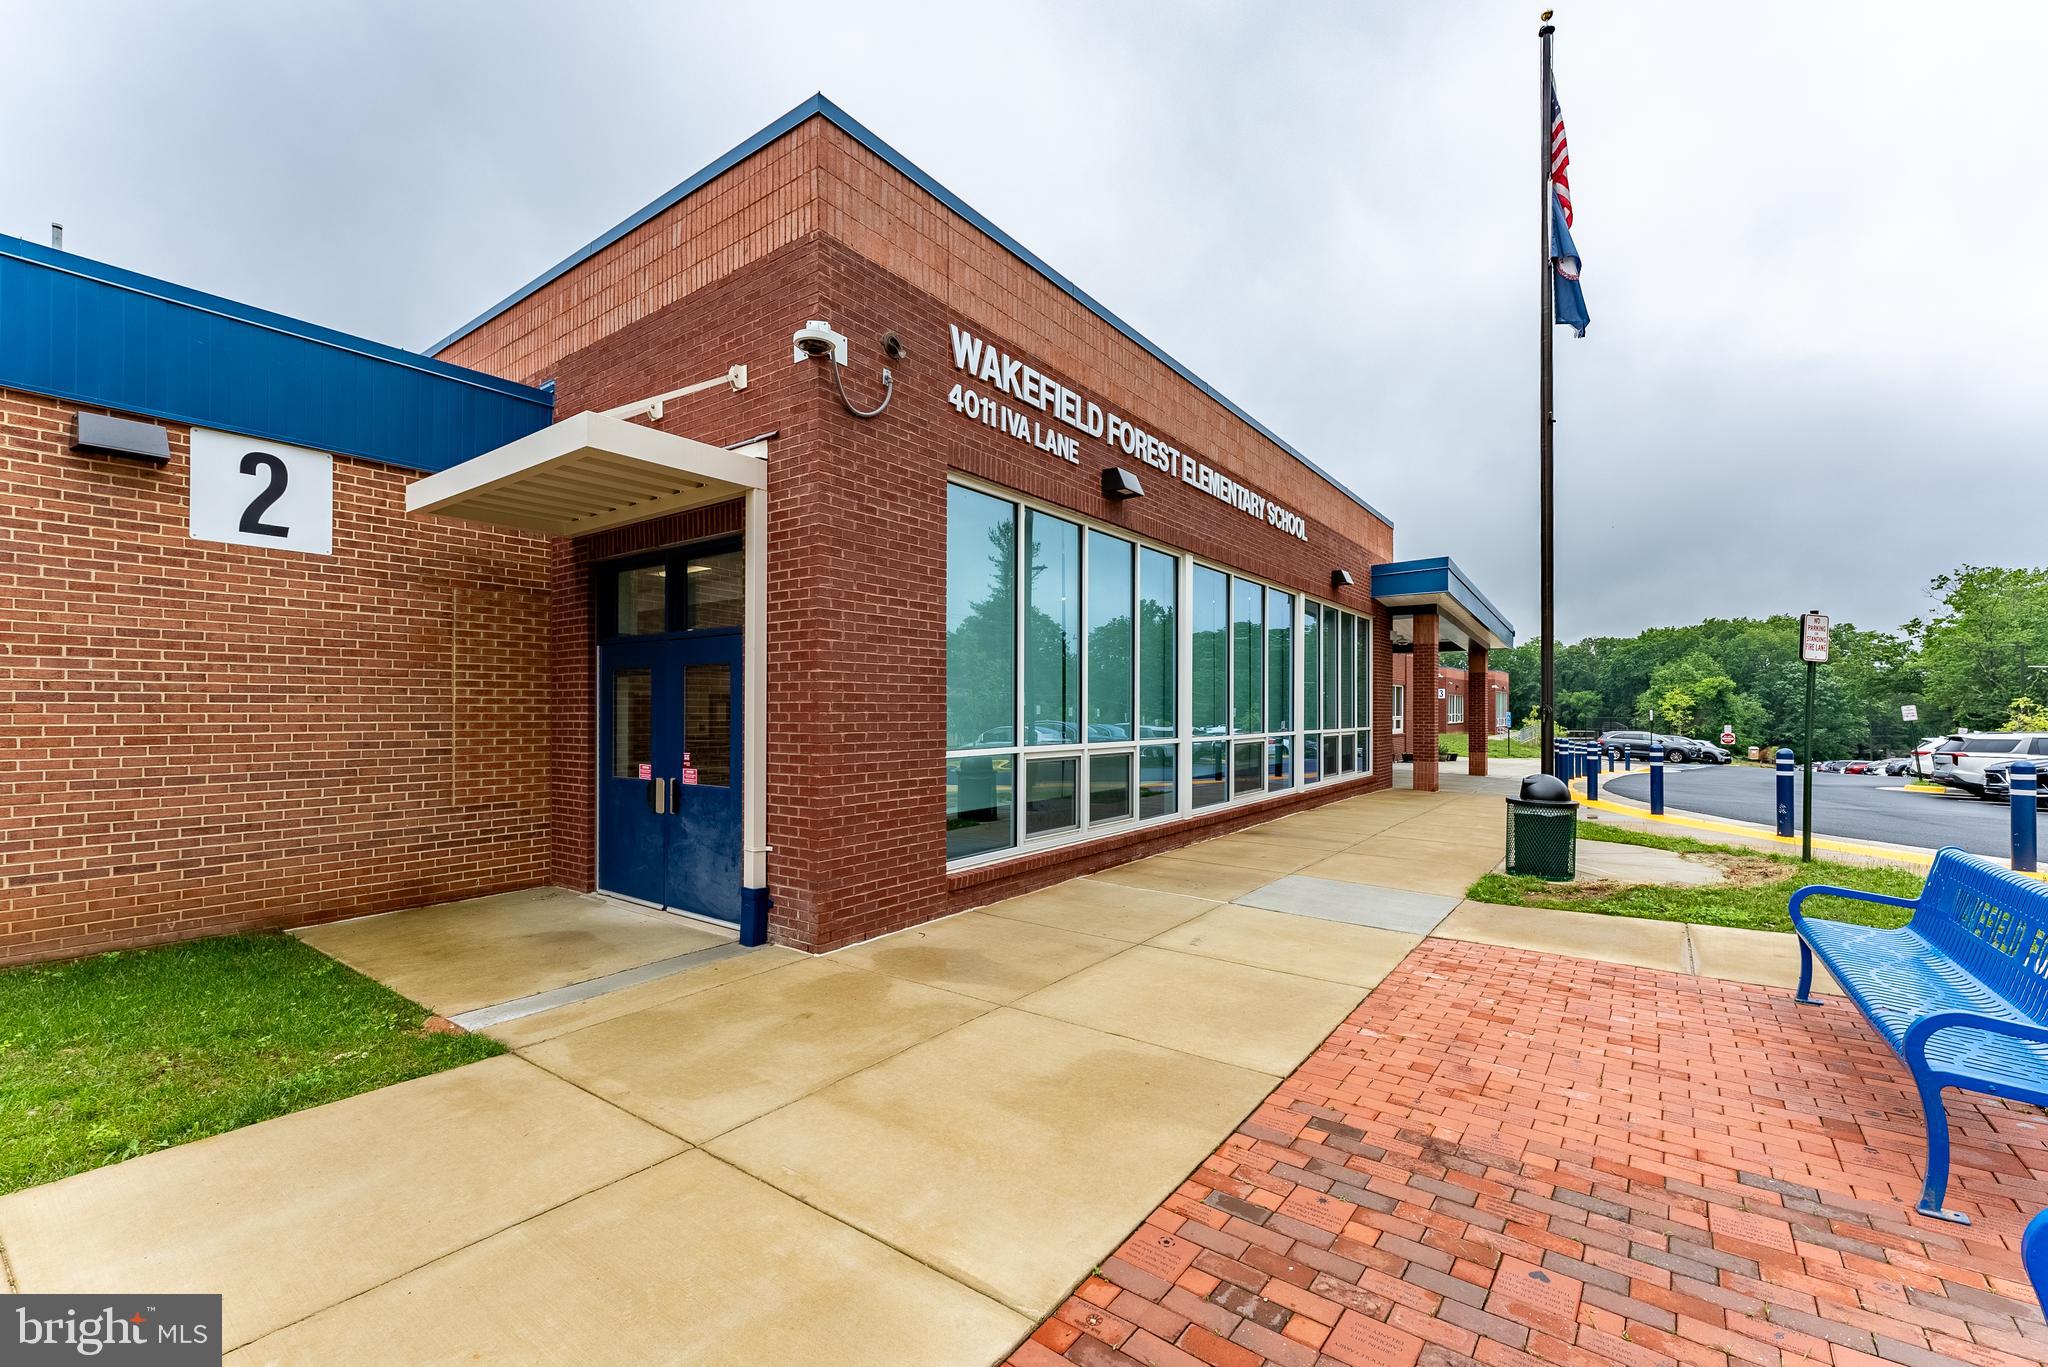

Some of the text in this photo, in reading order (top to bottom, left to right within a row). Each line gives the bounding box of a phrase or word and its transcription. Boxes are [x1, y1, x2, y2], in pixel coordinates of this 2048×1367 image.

[948, 383, 1080, 465] 4011 IVA LANE
[949, 323, 1308, 542] WAKEFIELD FOREST ELEMENTARY SCHOOL
[239, 451, 290, 539] 2
[1806, 643, 1826, 652] FIRE LANE
[1807, 624, 1826, 632] PARKING
[1439, 689, 1444, 698] 3
